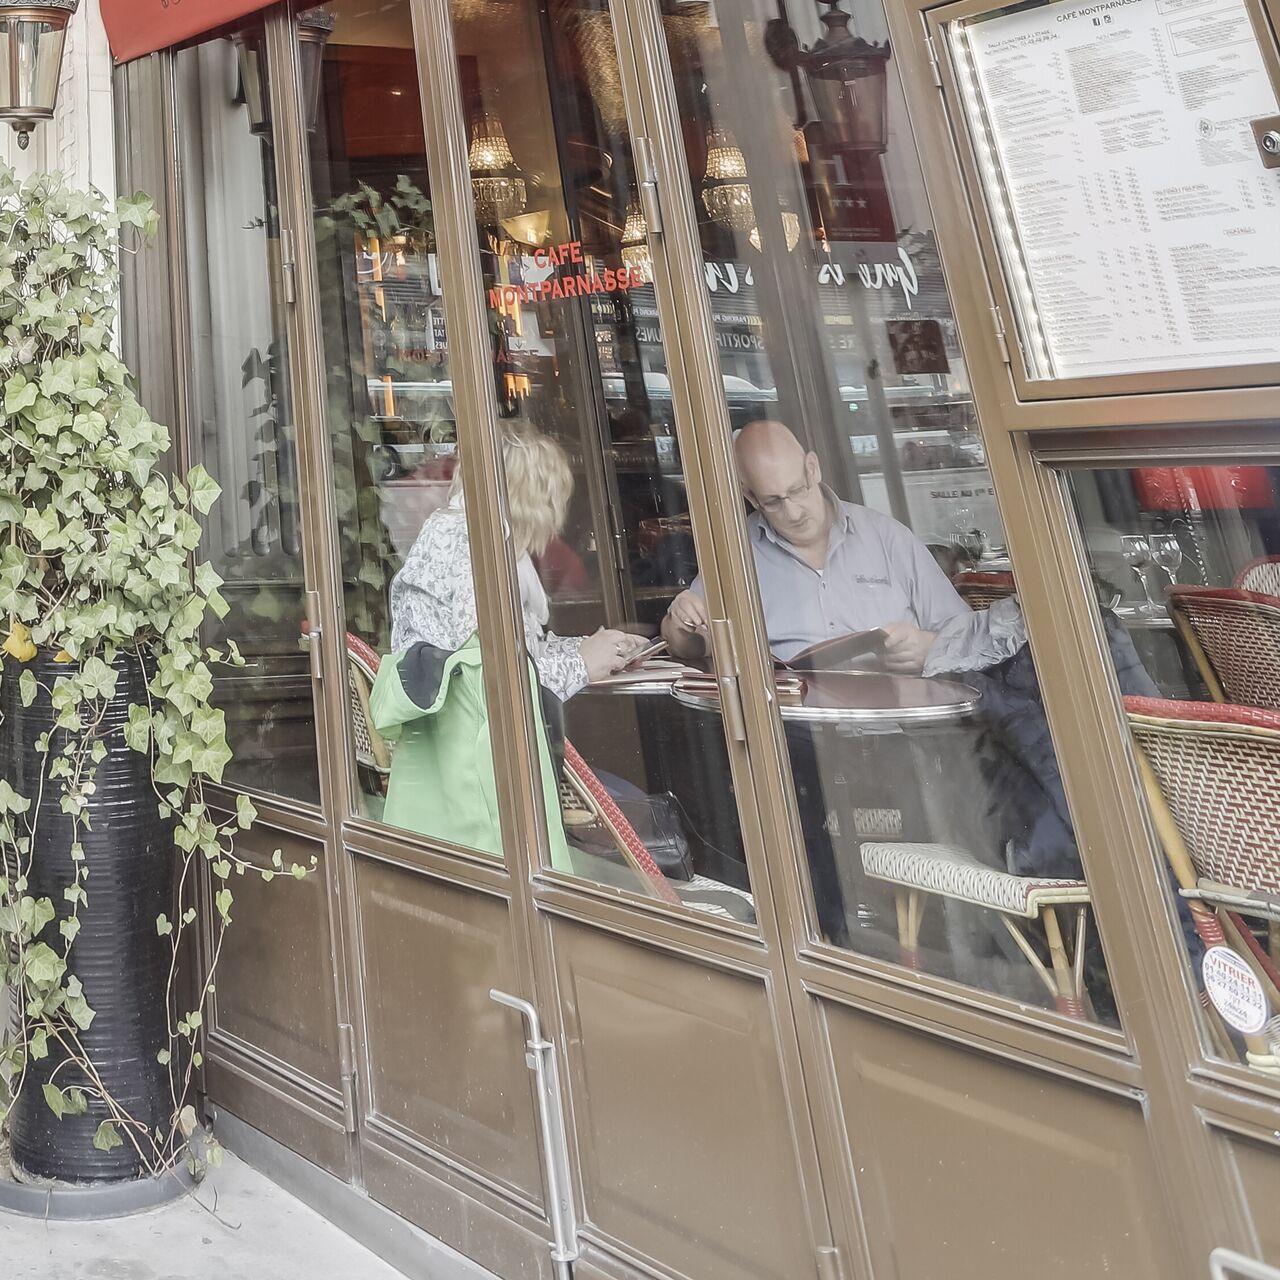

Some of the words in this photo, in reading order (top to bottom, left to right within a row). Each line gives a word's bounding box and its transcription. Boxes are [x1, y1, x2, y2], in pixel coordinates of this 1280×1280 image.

[534, 241, 583, 269] CAFE
[489, 265, 644, 309] MONTPARNASSE
[1210, 955, 1255, 988] VITRIER
